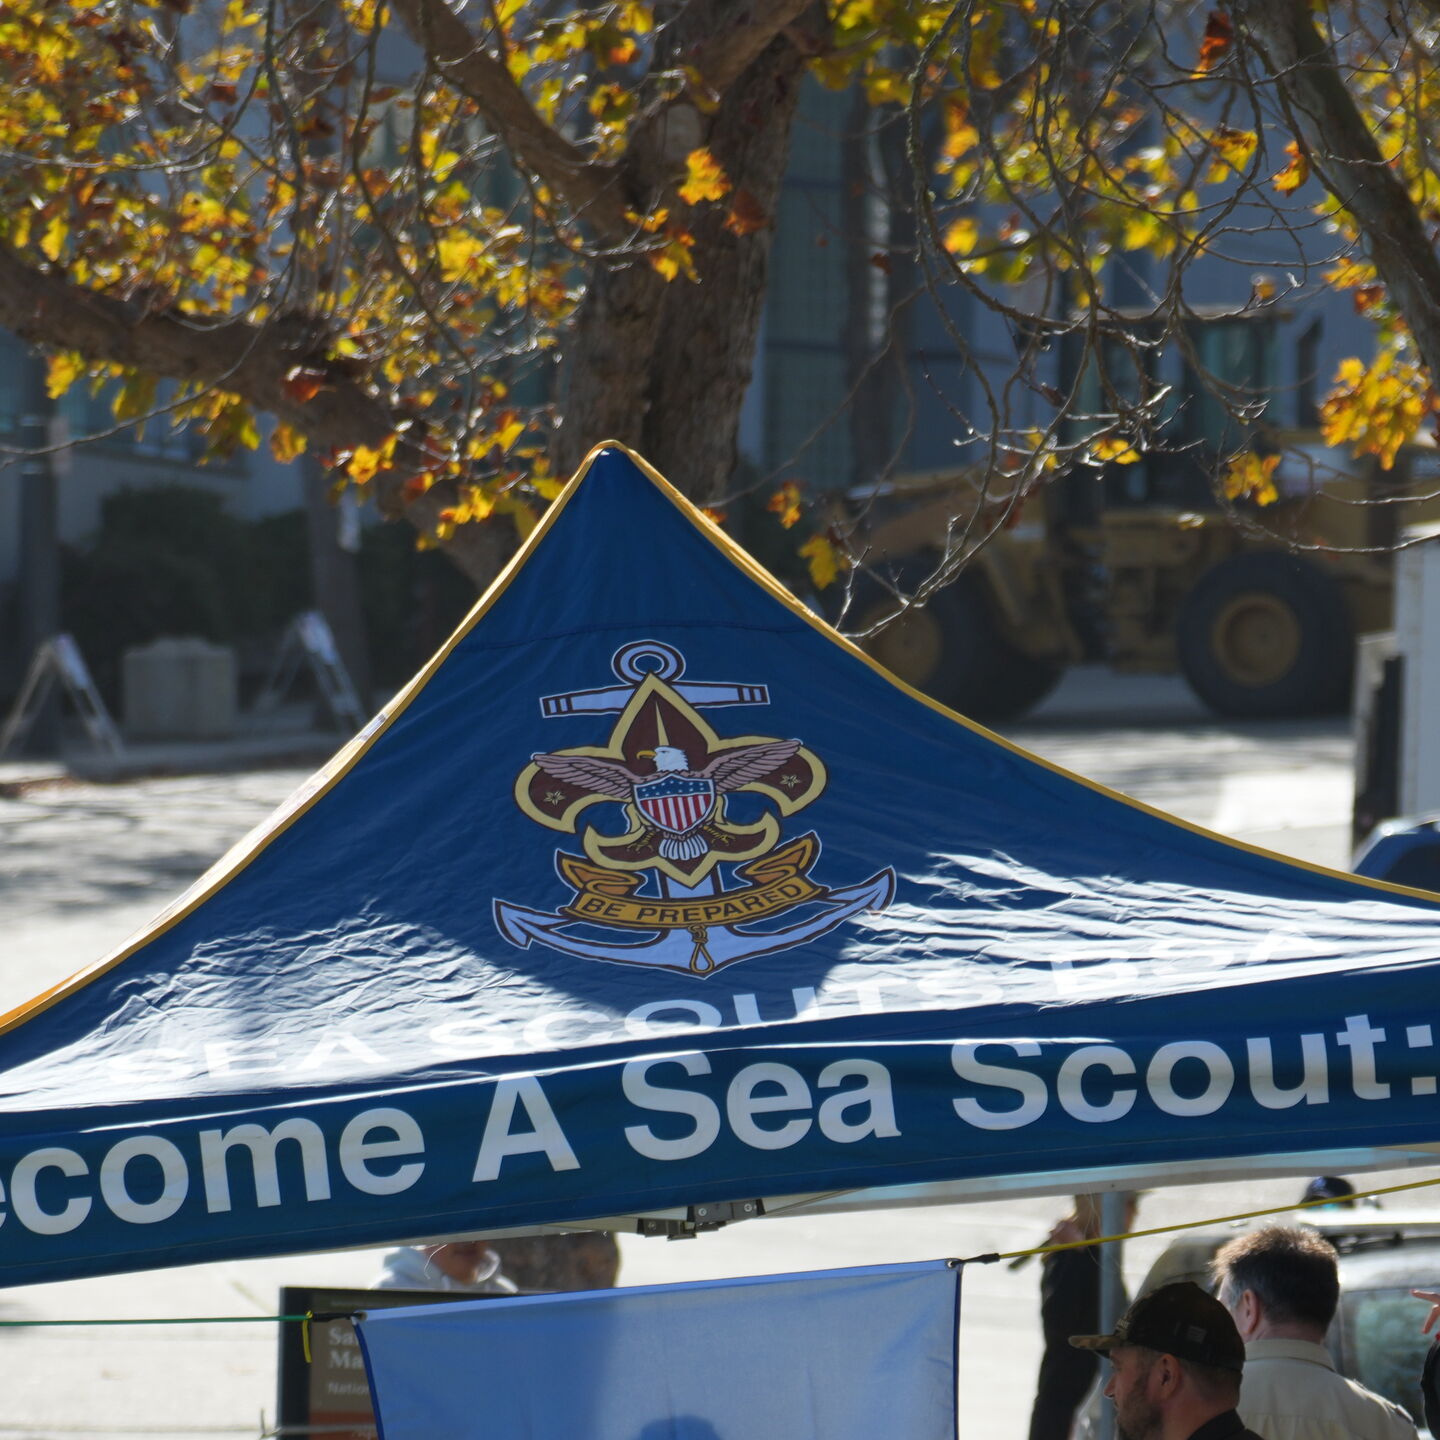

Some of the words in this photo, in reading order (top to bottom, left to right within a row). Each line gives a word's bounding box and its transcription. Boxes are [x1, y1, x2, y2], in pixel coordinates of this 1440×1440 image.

[582, 898, 626, 918] BE
[636, 884, 803, 922] PREPARED
[472, 1074, 579, 1182] A
[621, 1049, 901, 1161] Sea
[951, 1013, 1438, 1131] Scout:
[329, 1327, 358, 1346] Sa
